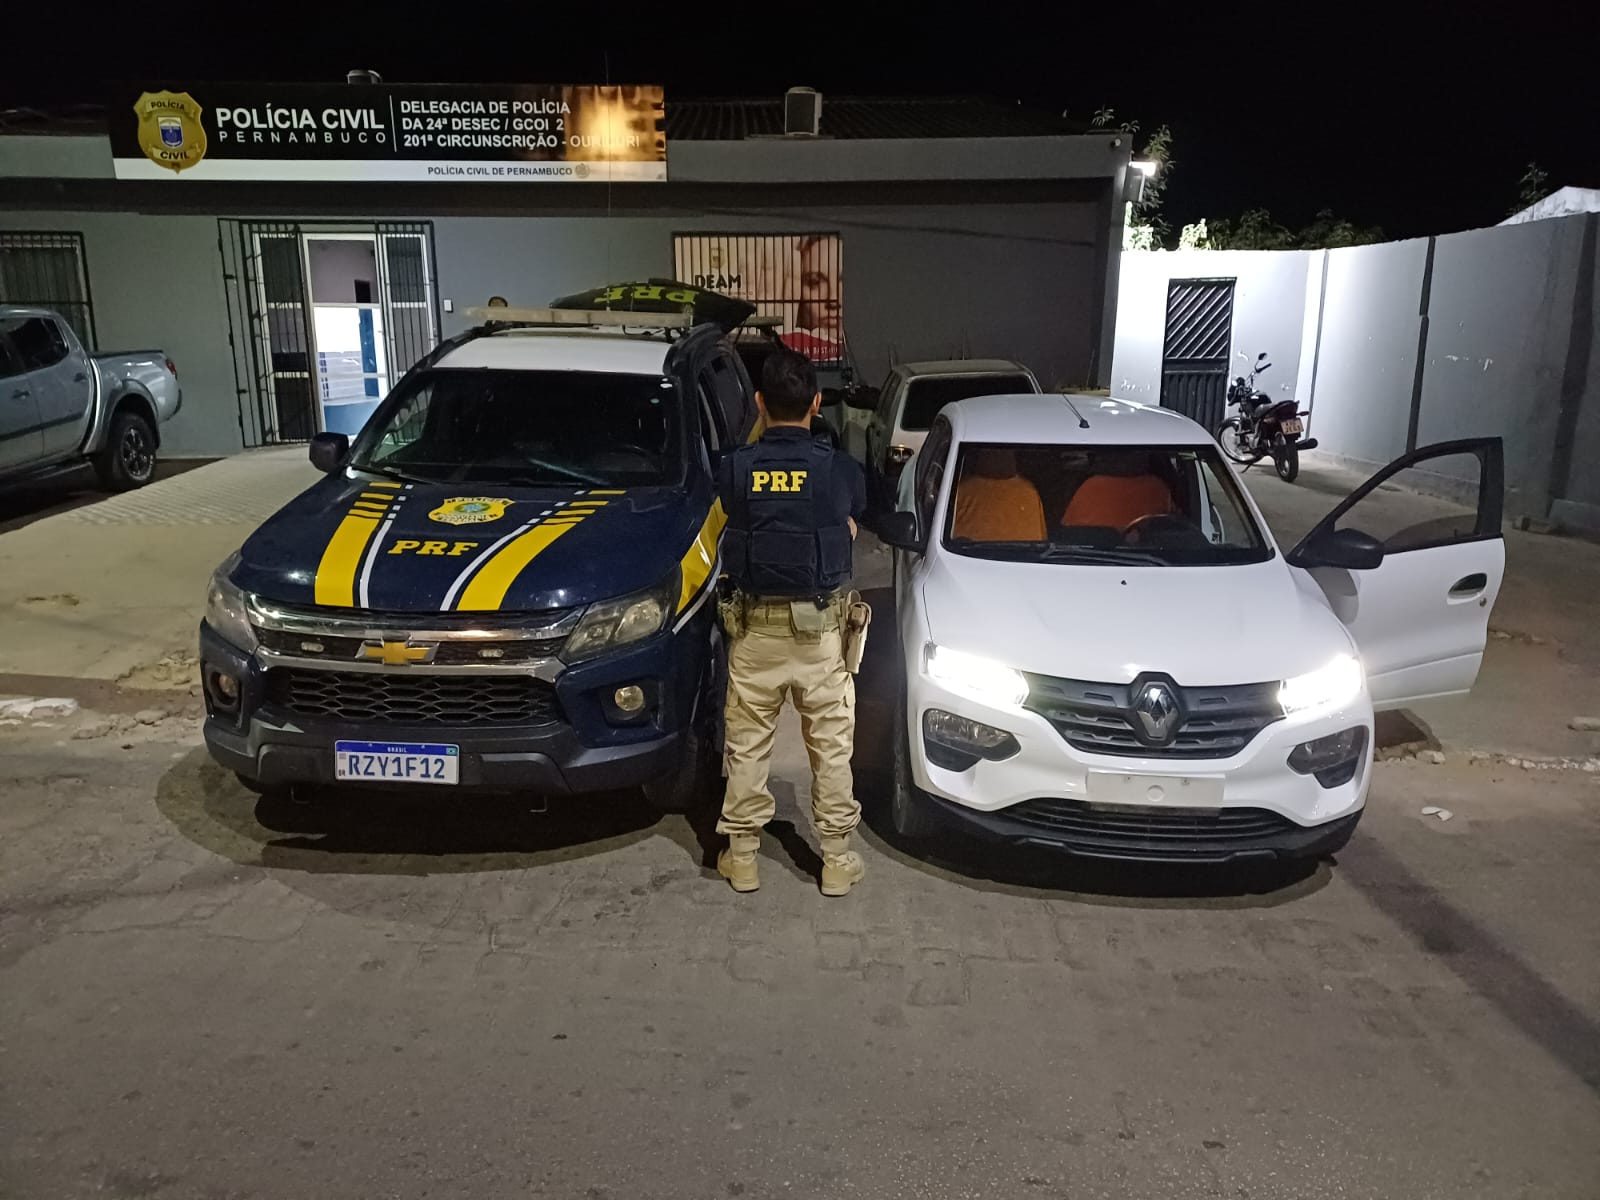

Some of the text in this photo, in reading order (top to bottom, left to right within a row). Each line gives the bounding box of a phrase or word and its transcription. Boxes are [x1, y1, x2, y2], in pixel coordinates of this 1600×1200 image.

[150, 99, 185, 110] POLÍCIA
[400, 98, 570, 115] DELEGACIA DE POLÍCIA
[215, 103, 385, 130] POLÍCIA CIVIL
[402, 118, 423, 131] DA
[451, 118, 501, 131] DESEC
[512, 118, 549, 131] GCOI
[556, 118, 564, 131] 2
[219, 131, 386, 144] PERNAMBUCO
[436, 132, 557, 151] CIRCUNSCRIÇÃO
[160, 151, 189, 160] CIVIL
[428, 166, 573, 176] POLÍCIA CIVIL DE PERNAMBUCO
[694, 274, 741, 289] DEAM
[751, 470, 808, 493] PRF
[388, 540, 478, 555] PRF
[387, 746, 407, 754] BRASIL
[348, 755, 446, 779] RZY1F12
